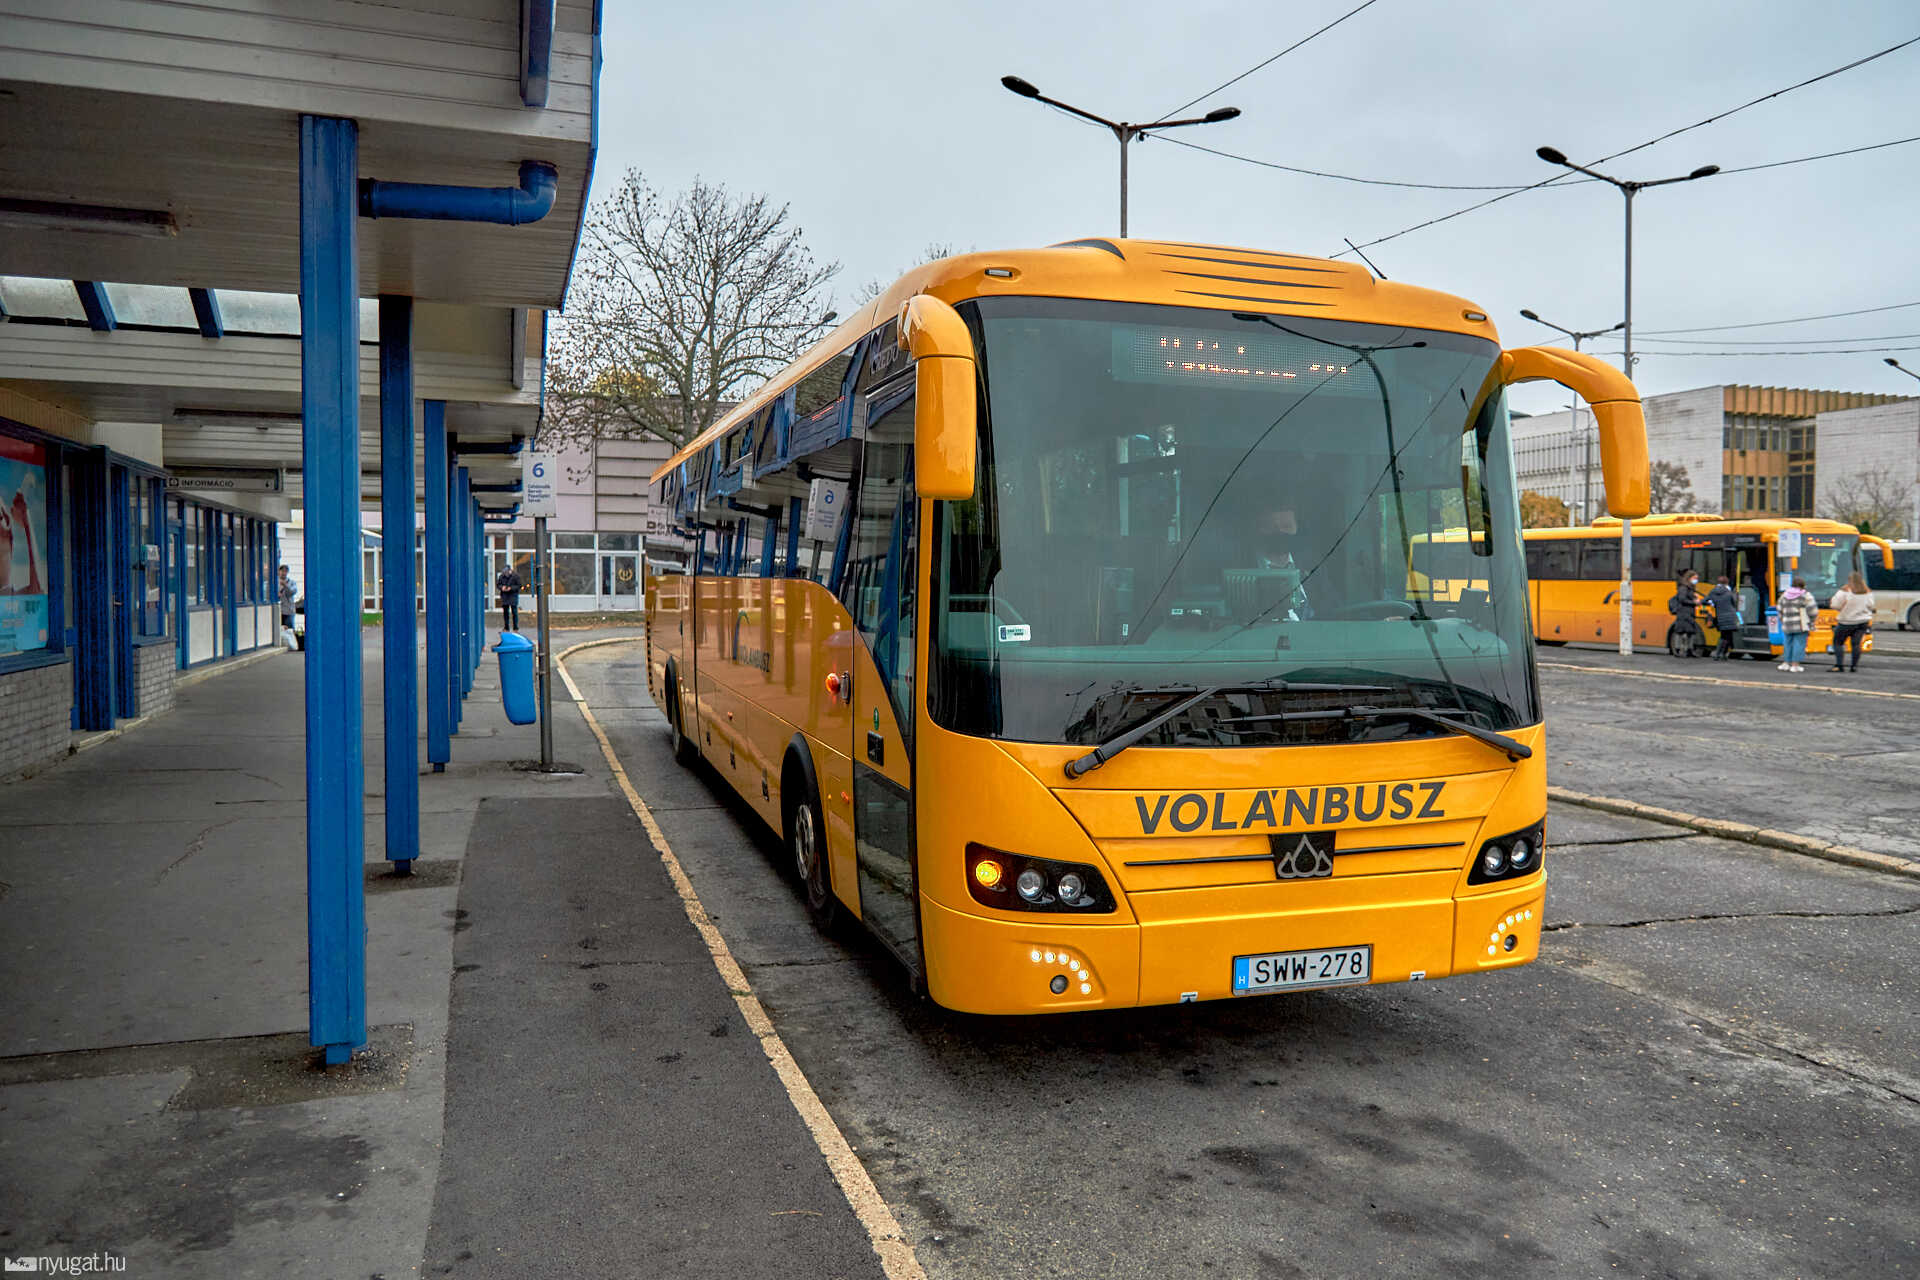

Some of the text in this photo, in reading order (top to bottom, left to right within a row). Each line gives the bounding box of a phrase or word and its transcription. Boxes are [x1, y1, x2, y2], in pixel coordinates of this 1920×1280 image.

[532, 462, 545, 478] 6
[1134, 781, 1448, 835] VOLÁNBUSZ
[1238, 951, 1363, 985] H SWW-278
